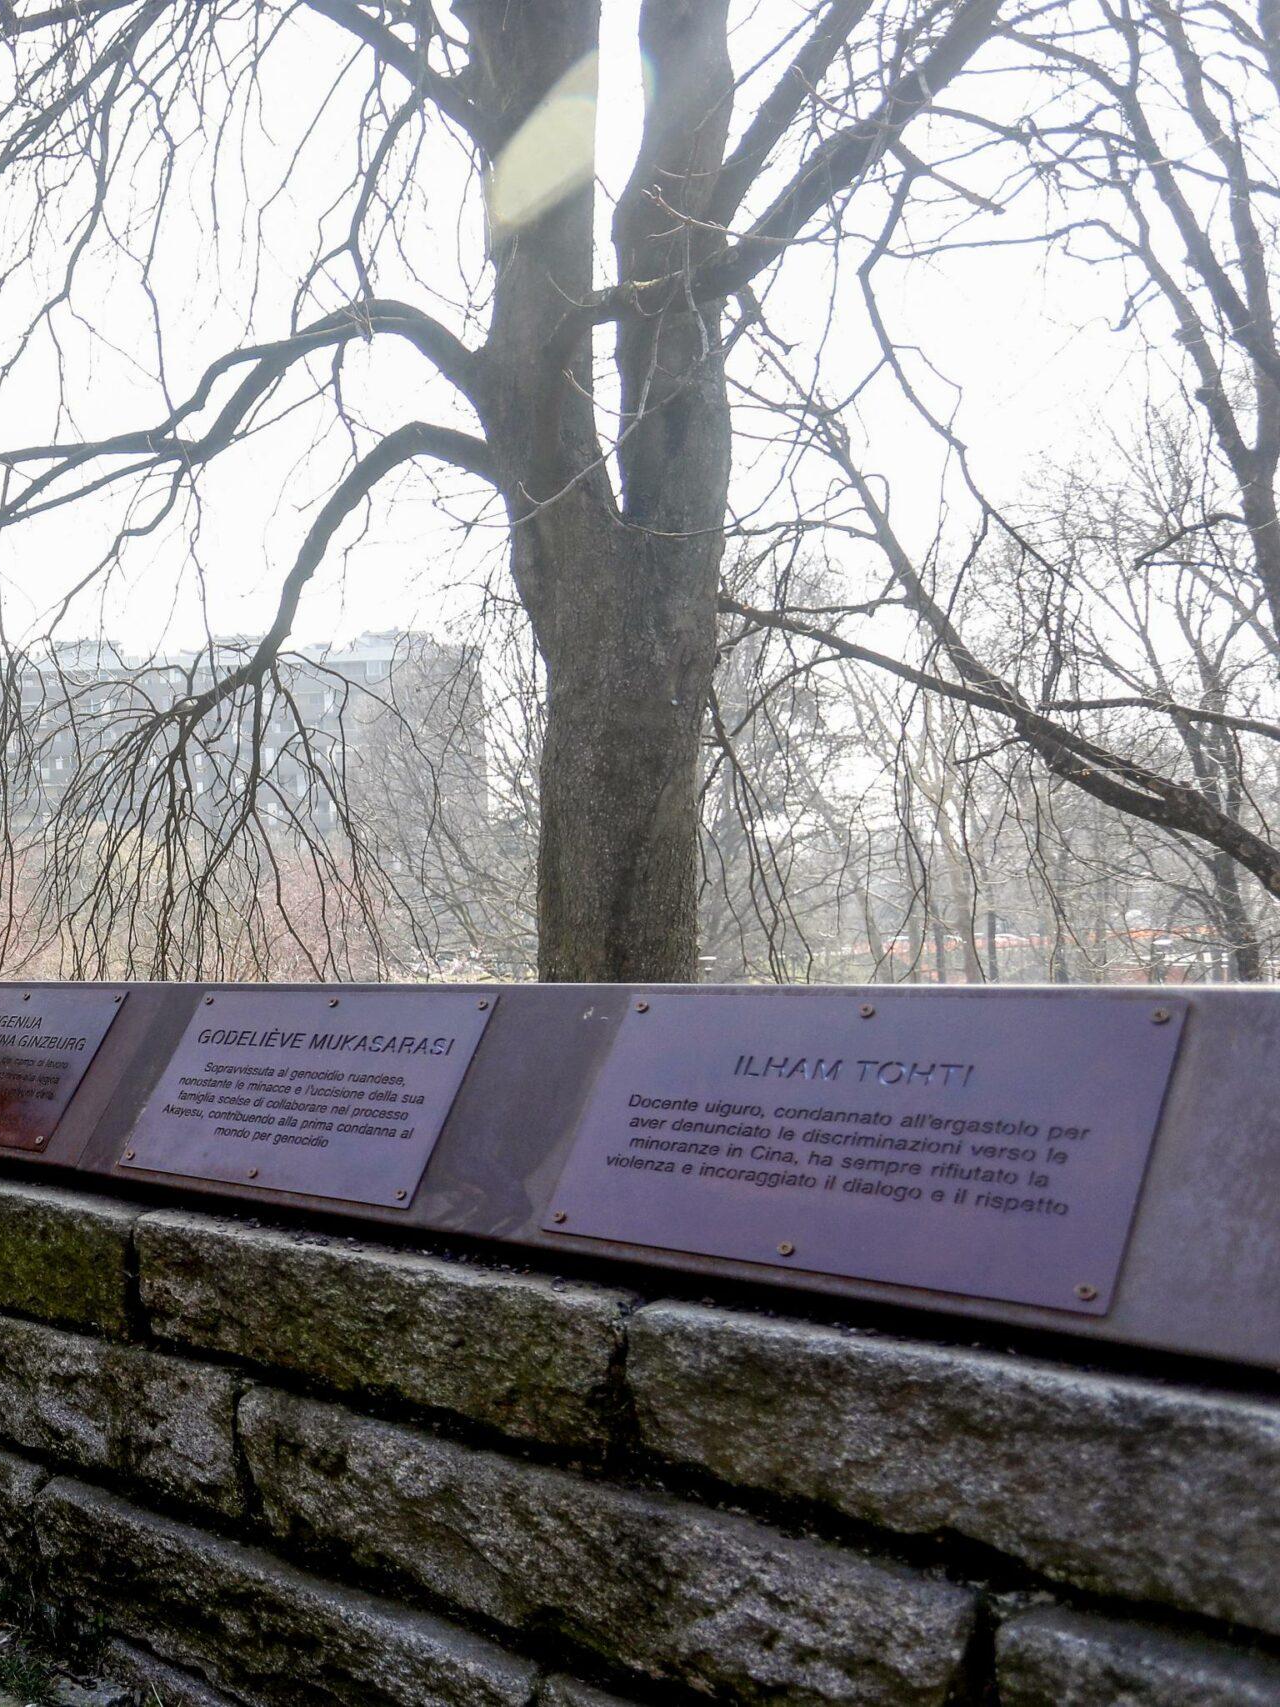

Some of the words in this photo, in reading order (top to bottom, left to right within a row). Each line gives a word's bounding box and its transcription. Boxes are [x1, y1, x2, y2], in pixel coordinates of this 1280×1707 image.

[18, 1035, 86, 1051] GINZBURG
[309, 1033, 455, 1056] MUKASARASI
[204, 1062, 275, 1076] Sopravvissuta
[277, 1067, 289, 1077] al
[290, 1069, 344, 1082] genocidio
[347, 1072, 406, 1087] ruandese,
[733, 1055, 843, 1081] ILHAM
[857, 1060, 974, 1087] TOHTI
[178, 1090, 215, 1104] famiglia
[218, 1094, 251, 1106] scelse
[253, 1097, 264, 1108] di
[266, 1099, 328, 1114] collaborare
[330, 1104, 350, 1116] nel
[351, 1107, 409, 1121] processo
[179, 1076, 232, 1089] nonostante
[235, 1079, 245, 1090] le
[247, 1081, 291, 1094] minacce
[294, 1086, 302, 1095] e
[305, 1085, 365, 1099] l'uccisione
[368, 1089, 398, 1103] della
[401, 1094, 425, 1105] sua
[162, 1104, 205, 1119] Akayesu,
[208, 1109, 275, 1125] contribuendo
[278, 1117, 298, 1128] alla
[300, 1118, 333, 1131] prima
[336, 1122, 397, 1137] condanna
[400, 1128, 414, 1139] al
[628, 1094, 698, 1111] Docente
[705, 1100, 765, 1118] uiguro,
[774, 1106, 892, 1126] condannato
[900, 1113, 1039, 1137] all'ergastolo
[1047, 1125, 1090, 1142] per
[214, 1126, 250, 1139] mondo
[252, 1130, 272, 1142] per
[273, 1134, 329, 1147] genocidio
[629, 1116, 667, 1129] aver
[672, 1115, 770, 1138] denunciato
[778, 1126, 795, 1141] le
[802, 1128, 962, 1155] discriminazioni
[971, 1144, 1036, 1162] verso
[1046, 1147, 1068, 1165] le
[629, 1136, 719, 1156] minoranze
[726, 1143, 743, 1158] in
[751, 1145, 799, 1164] Cina,
[808, 1150, 833, 1166] ha
[841, 1155, 921, 1175] sempre
[930, 1162, 1018, 1185] rifiutato
[1027, 1171, 1050, 1188] la
[606, 1153, 675, 1173] violenza
[681, 1163, 693, 1175] e
[699, 1162, 817, 1188] incoraggiato
[824, 1175, 837, 1190] il
[842, 1178, 922, 1202] dialogo
[930, 1189, 945, 1201] e
[954, 1188, 968, 1205] il
[974, 1191, 1069, 1216] rispetto
